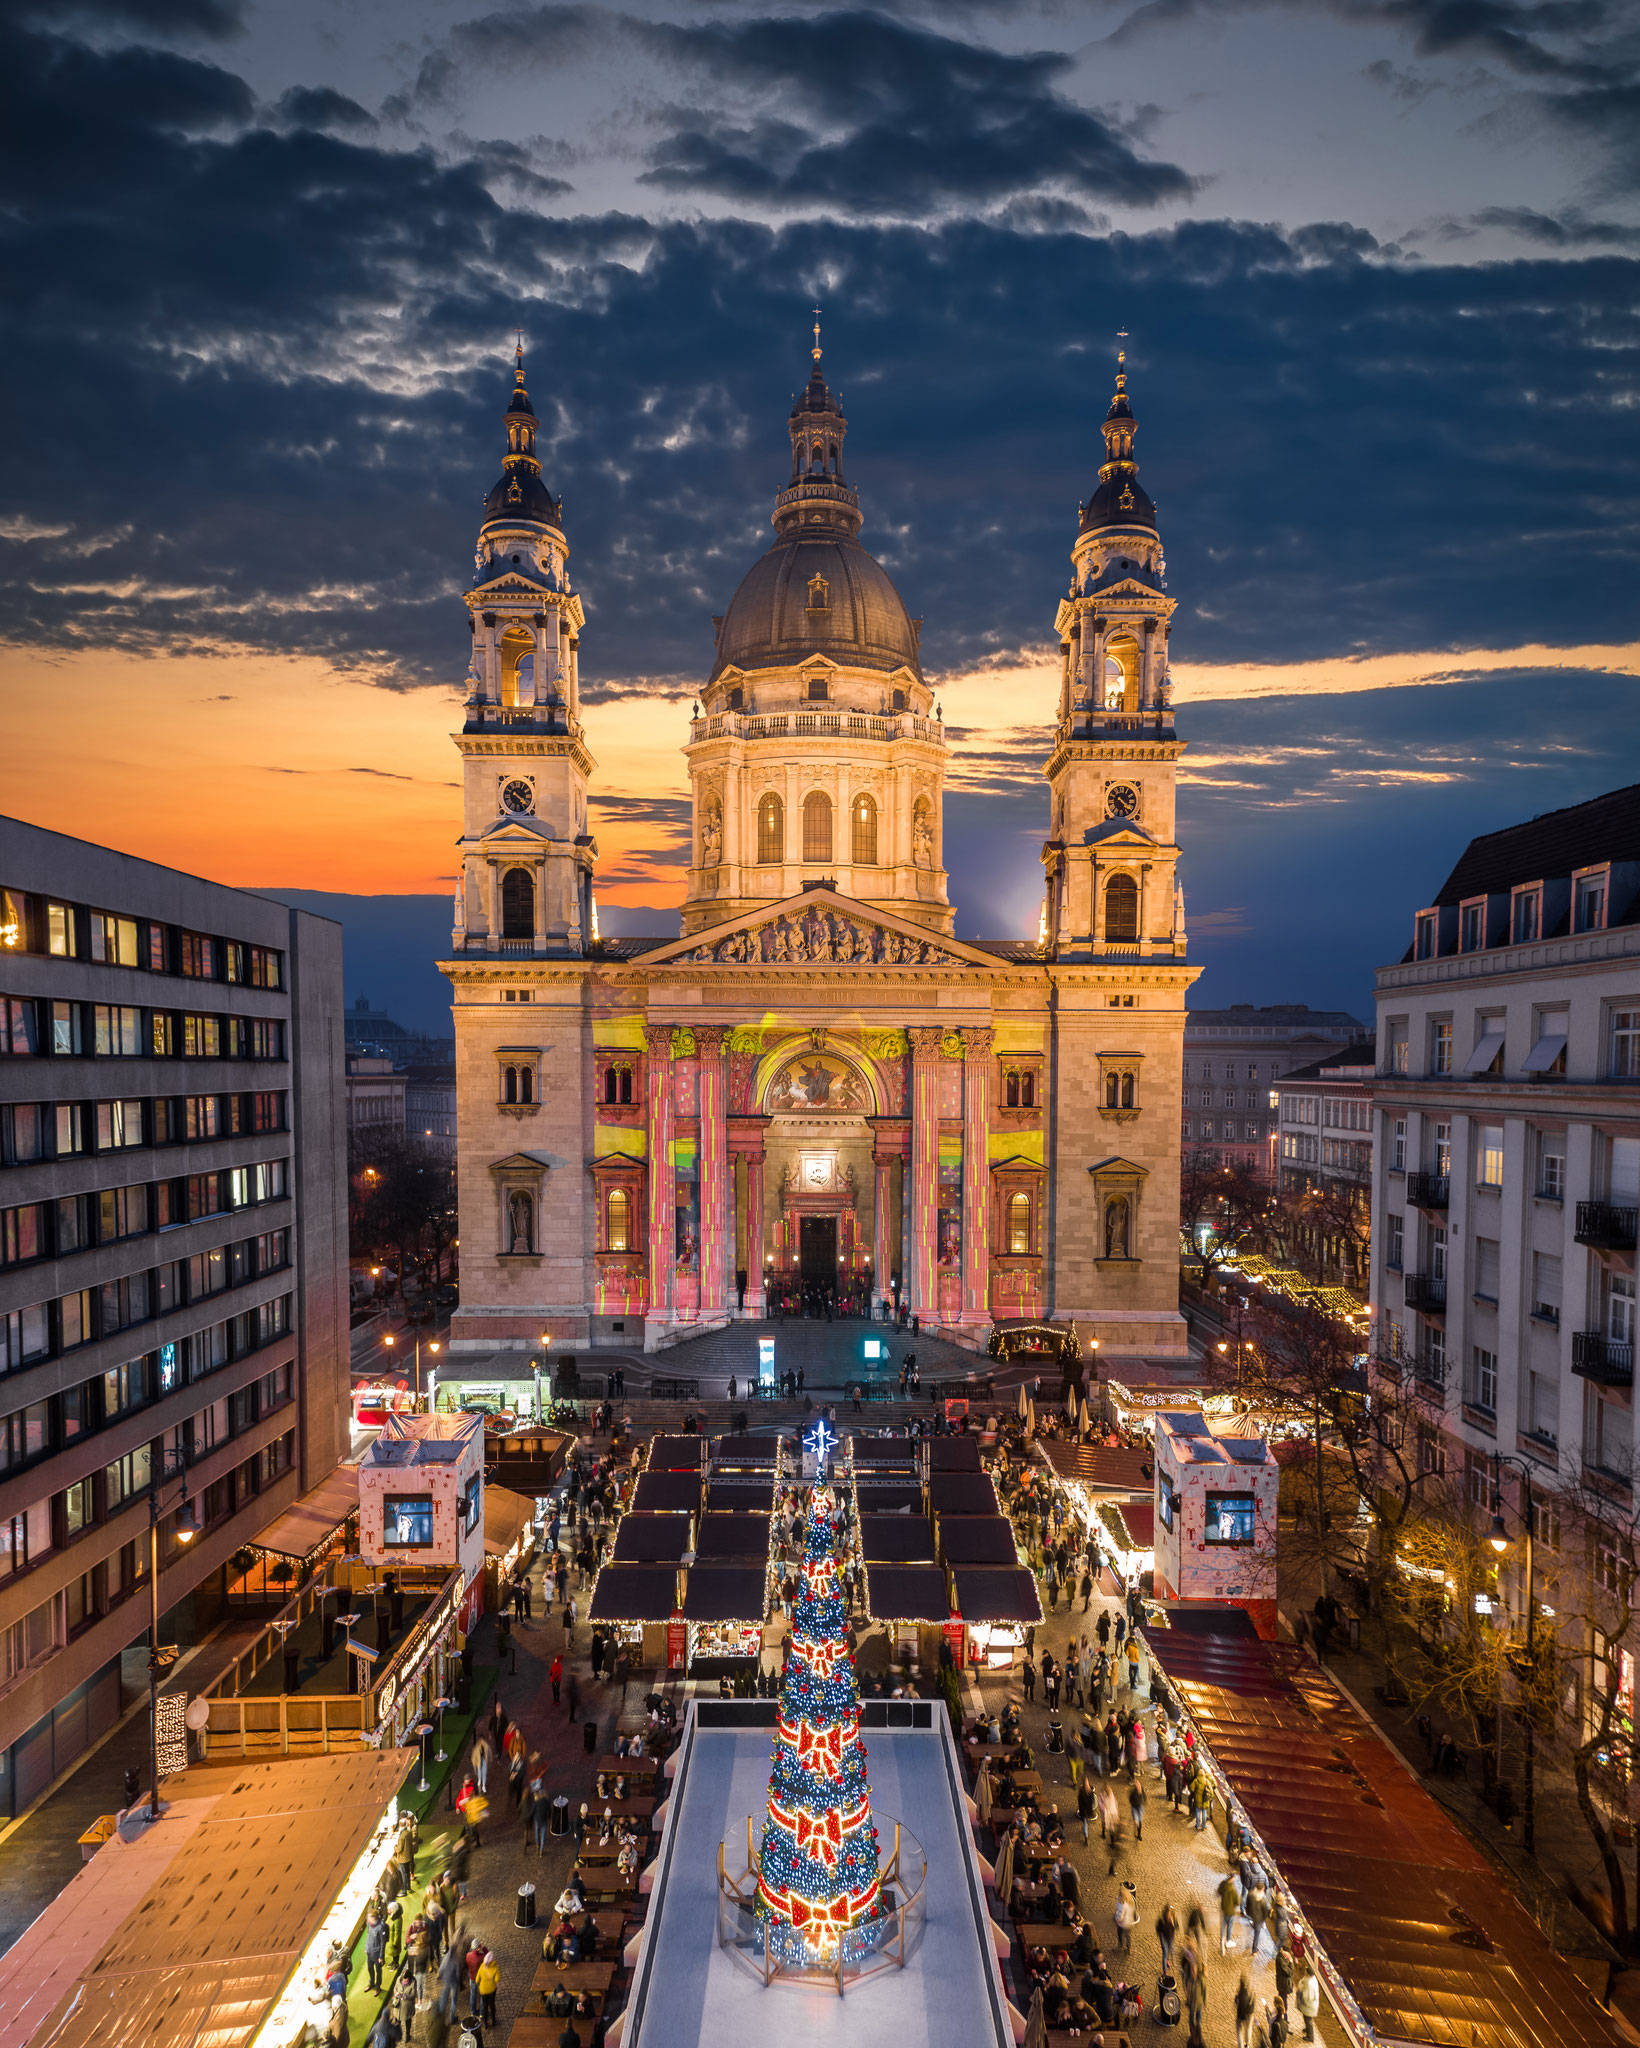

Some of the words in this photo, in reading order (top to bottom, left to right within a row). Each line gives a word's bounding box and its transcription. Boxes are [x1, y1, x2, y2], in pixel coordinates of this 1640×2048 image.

[715, 991, 741, 1001] EGO
[750, 991, 777, 1001] SUM
[787, 991, 807, 1001] VIA
[816, 991, 866, 1002] VERITAS
[874, 992, 888, 1002] ET
[898, 992, 923, 1002] VITA
